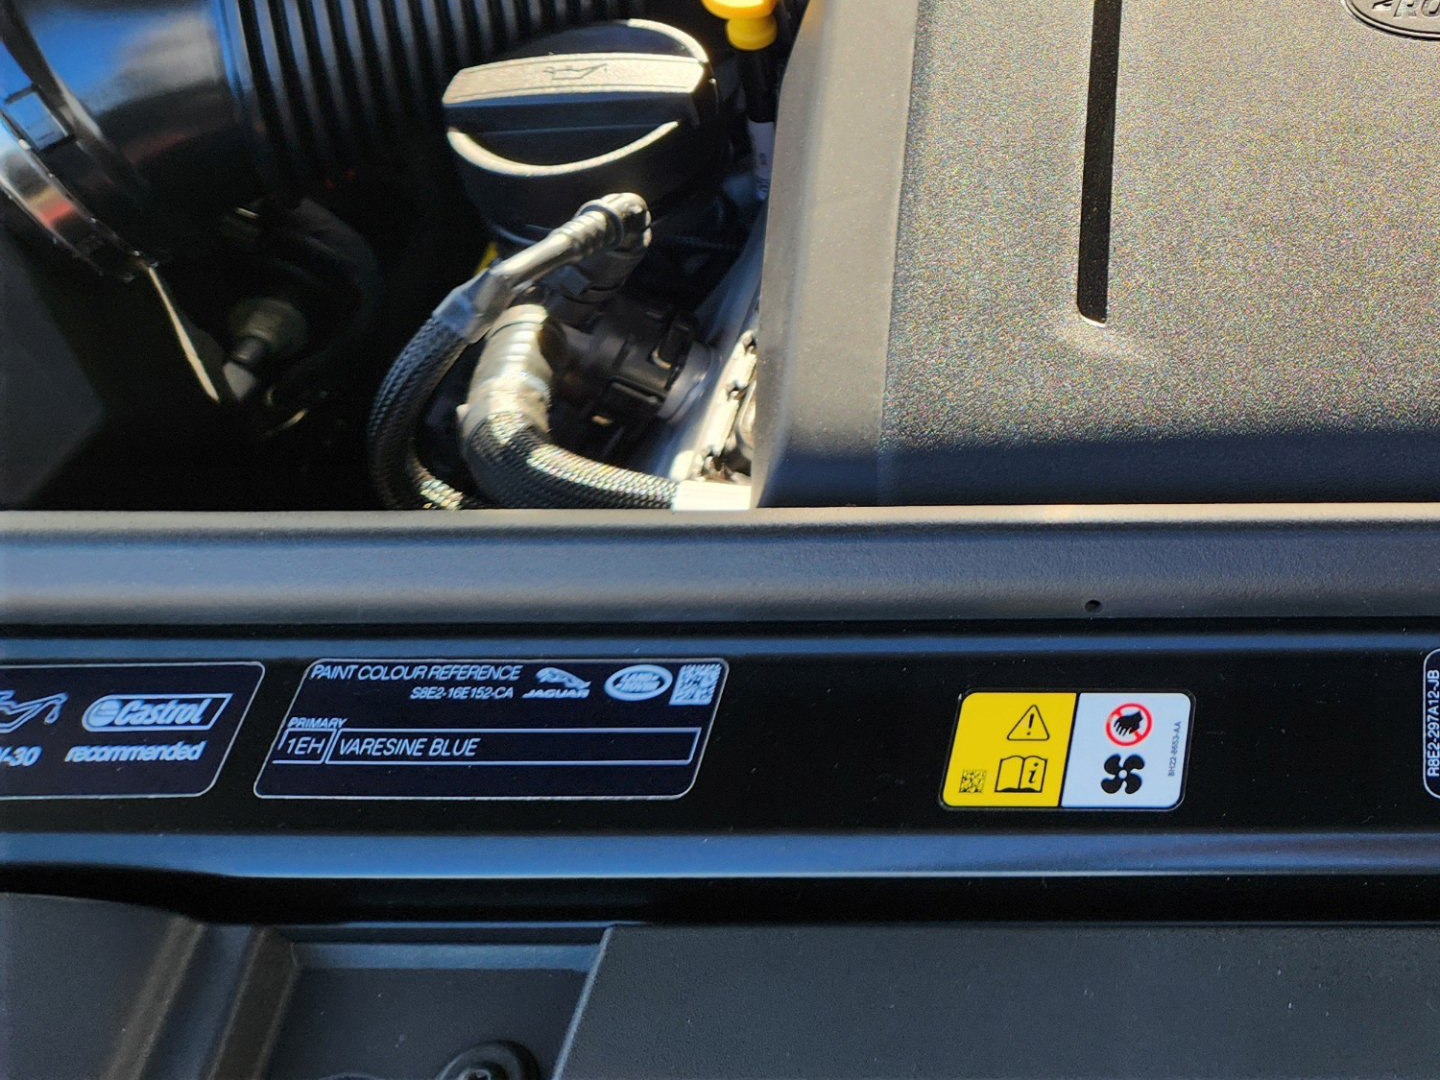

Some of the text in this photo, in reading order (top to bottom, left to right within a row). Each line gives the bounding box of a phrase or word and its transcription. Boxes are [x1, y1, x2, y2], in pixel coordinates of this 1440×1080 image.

[310, 664, 523, 680] PAINT COLOUR REFERENCE
[521, 688, 590, 699] JAGUAR
[114, 697, 211, 726] Castrol
[287, 716, 348, 728] PRIMARY
[1426, 669, 1440, 777] R8E2-297A12-JB
[64, 740, 208, 762] recommended
[287, 737, 481, 756] 1EH VARESINE BLUE
